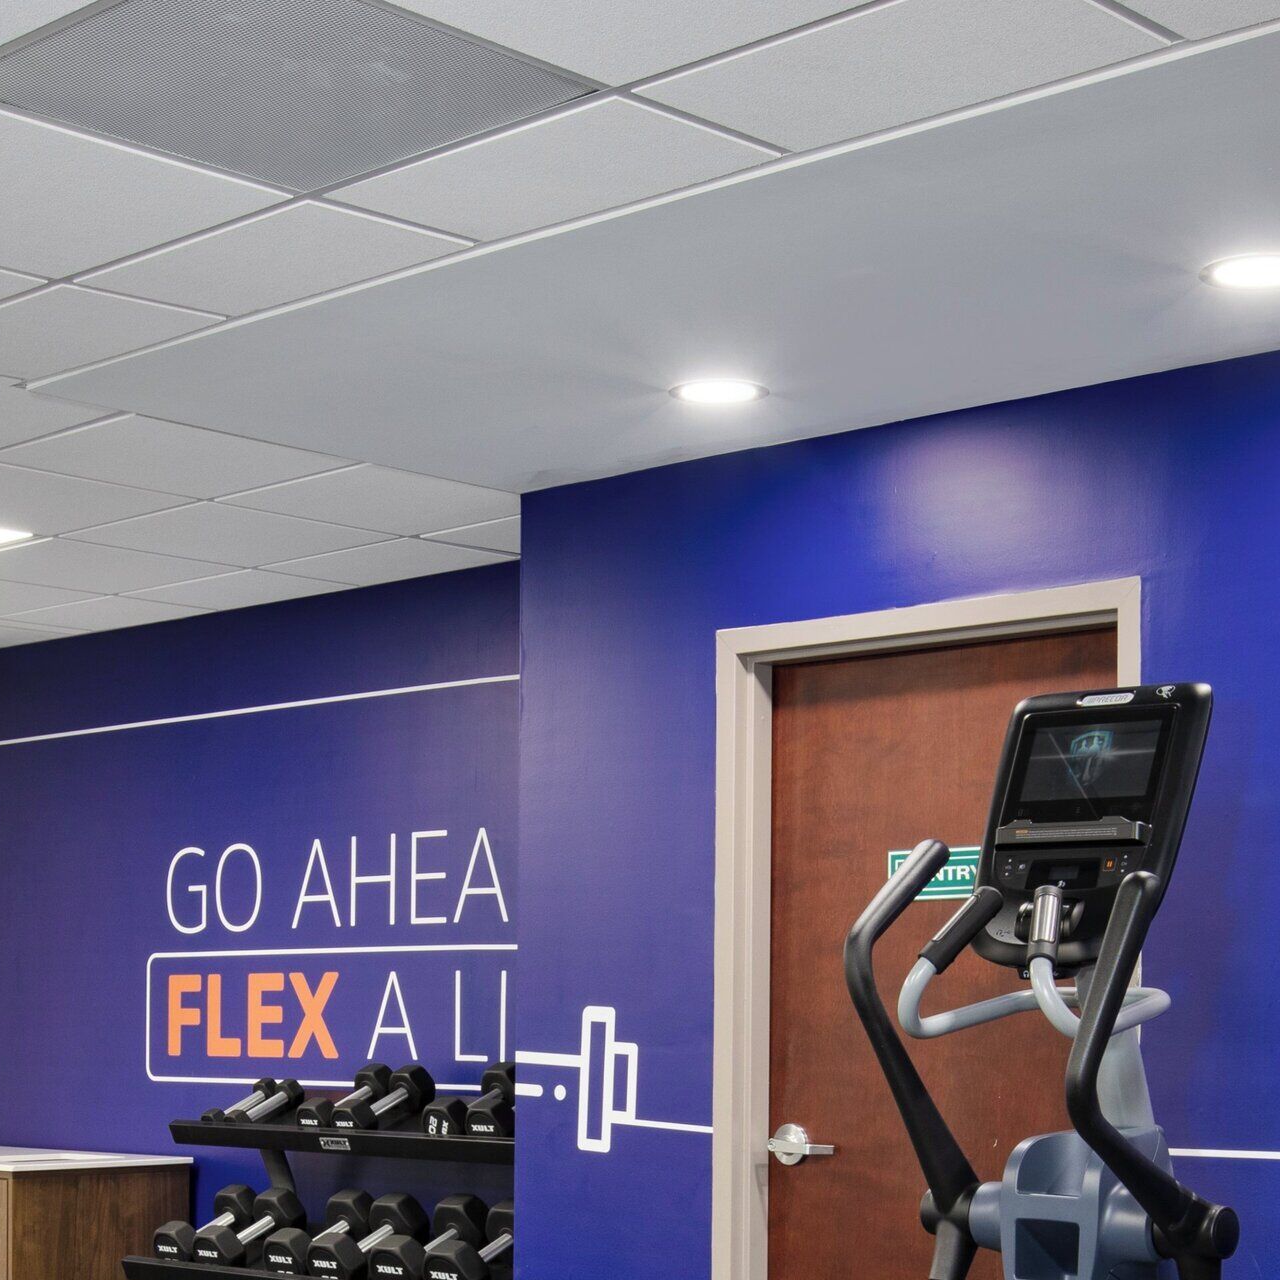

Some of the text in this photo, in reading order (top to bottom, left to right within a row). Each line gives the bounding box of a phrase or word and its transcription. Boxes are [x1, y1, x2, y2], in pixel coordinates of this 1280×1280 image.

[931, 864, 978, 882] NTR
[166, 843, 262, 934] GO
[168, 972, 340, 1059] FLEX
[367, 971, 418, 1060] A
[300, 1118, 319, 1126] XULT
[335, 1120, 354, 1128] XULT
[471, 1124, 495, 1132] XULT
[157, 1244, 178, 1254] XULT
[197, 1249, 218, 1258] XULT
[269, 1254, 293, 1265] XULT
[312, 1259, 337, 1270] XULT
[376, 1264, 404, 1275] XULT
